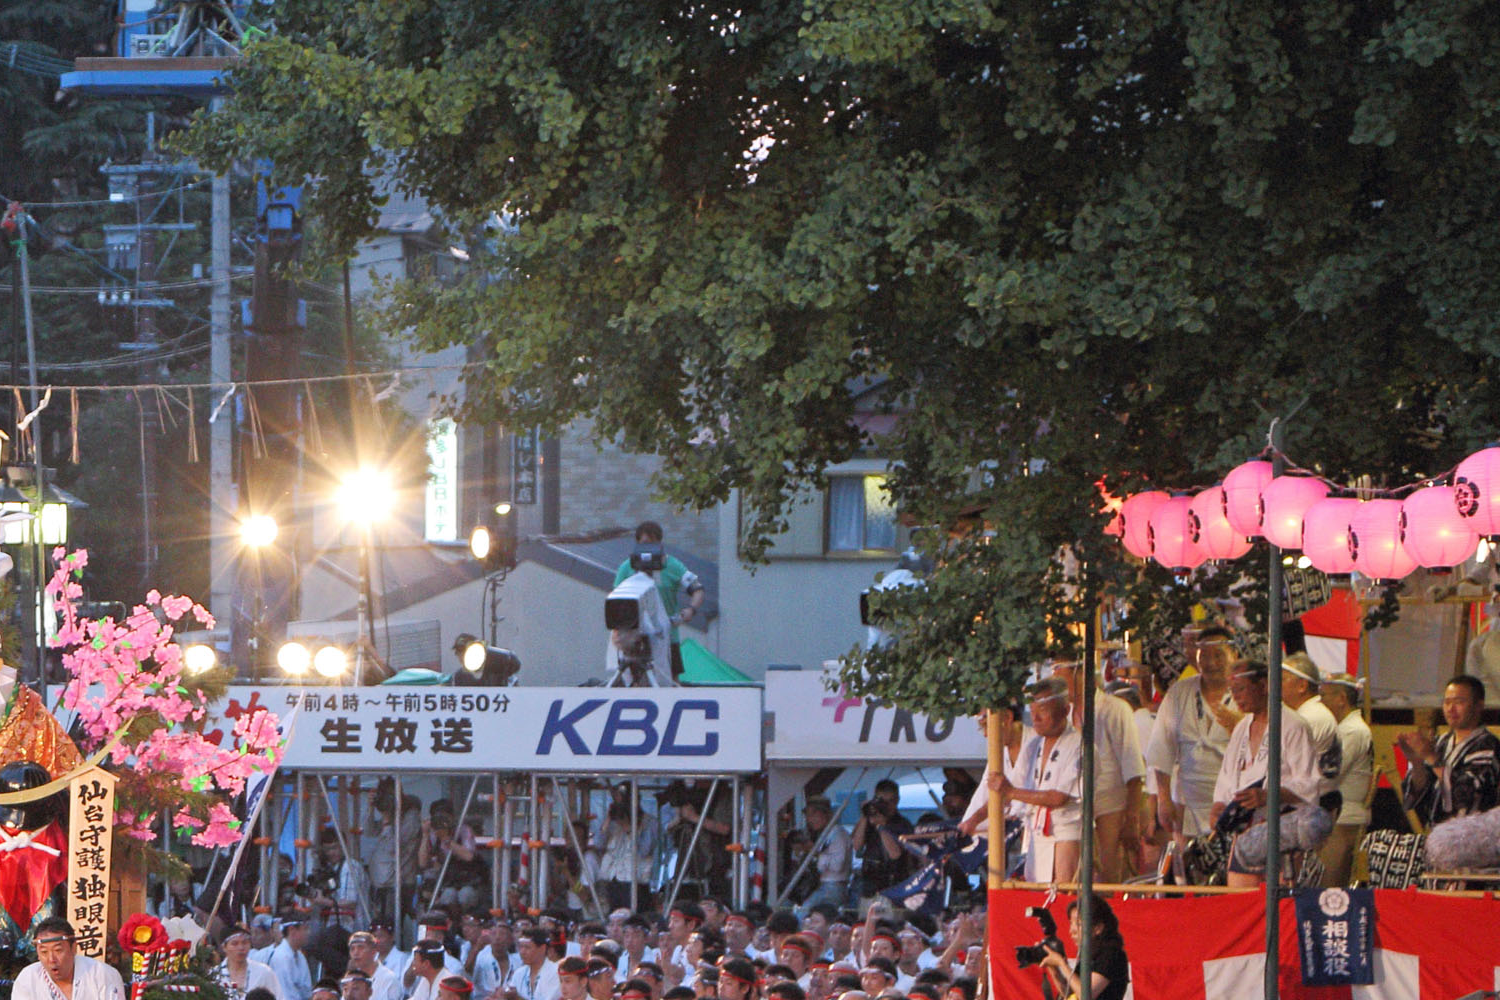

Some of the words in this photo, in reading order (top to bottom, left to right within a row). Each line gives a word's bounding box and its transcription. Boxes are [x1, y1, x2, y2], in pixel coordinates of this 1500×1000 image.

[320, 716, 473, 754] 生放送
[536, 699, 720, 756] KBC
[71, 780, 109, 959] 仙台守護独眼竜
[1321, 919, 1352, 976] 相談役
